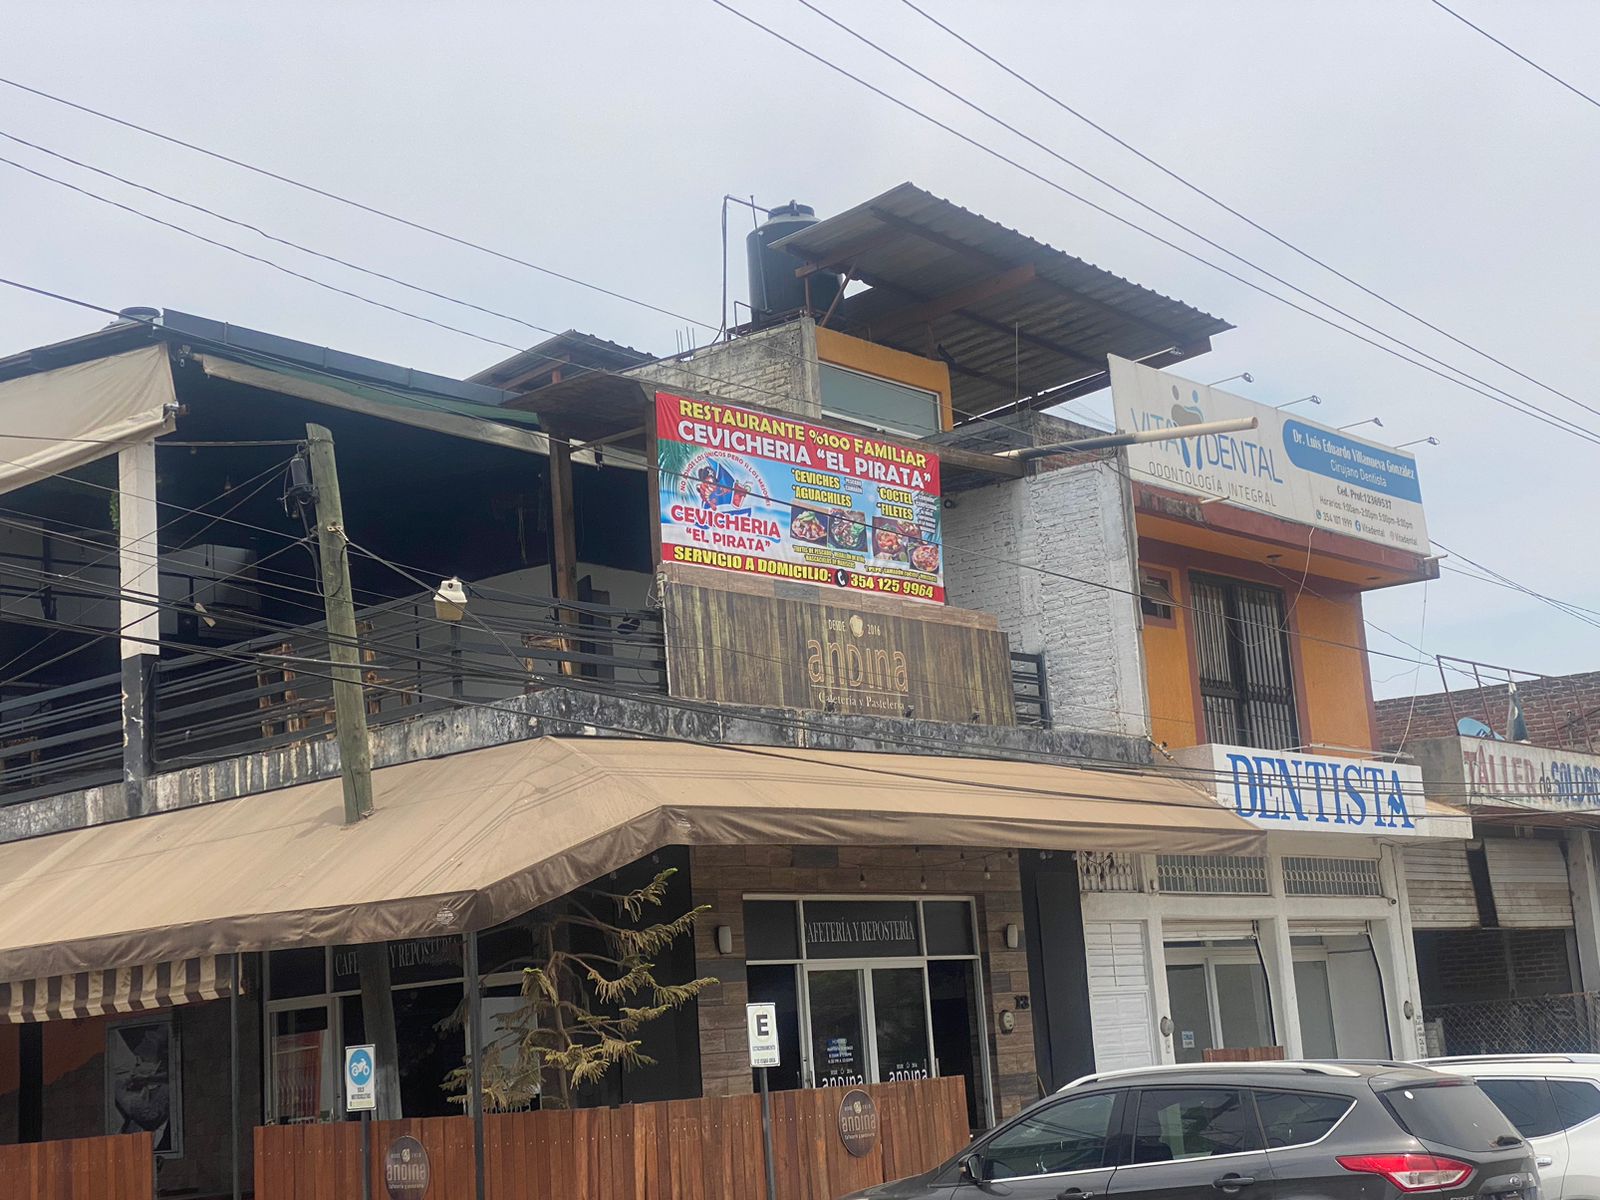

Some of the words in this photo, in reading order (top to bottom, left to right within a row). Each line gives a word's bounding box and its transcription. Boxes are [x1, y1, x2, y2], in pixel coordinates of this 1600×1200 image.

[678, 421, 811, 465] CEVICHERIA
[679, 400, 805, 441] RESTAURANTE
[809, 428, 850, 451] %100
[854, 438, 926, 469] FAMILIAR
[1292, 429, 1305, 444] Dr.
[1322, 438, 1351, 460] Eduardo
[1352, 448, 1386, 471] Villanueva
[1206, 433, 1283, 485] DENTAL
[1330, 459, 1359, 479] Cirujano
[1360, 468, 1387, 487] Dentista
[1227, 482, 1277, 507] INTEGRAL
[670, 505, 782, 539] CEVICHERIA
[673, 546, 743, 571] SERVICIO
[744, 555, 755, 572] A
[757, 559, 832, 584] DOMICILIO:
[850, 574, 877, 591] 354
[878, 577, 901, 595] 125
[902, 580, 934, 599] 9964
[1226, 753, 1415, 829] DENTISTA
[1463, 744, 1537, 800] TALLER
[853, 921, 861, 942] Y
[861, 915, 915, 942] REPOSTERÍA
[756, 1014, 769, 1036] E
